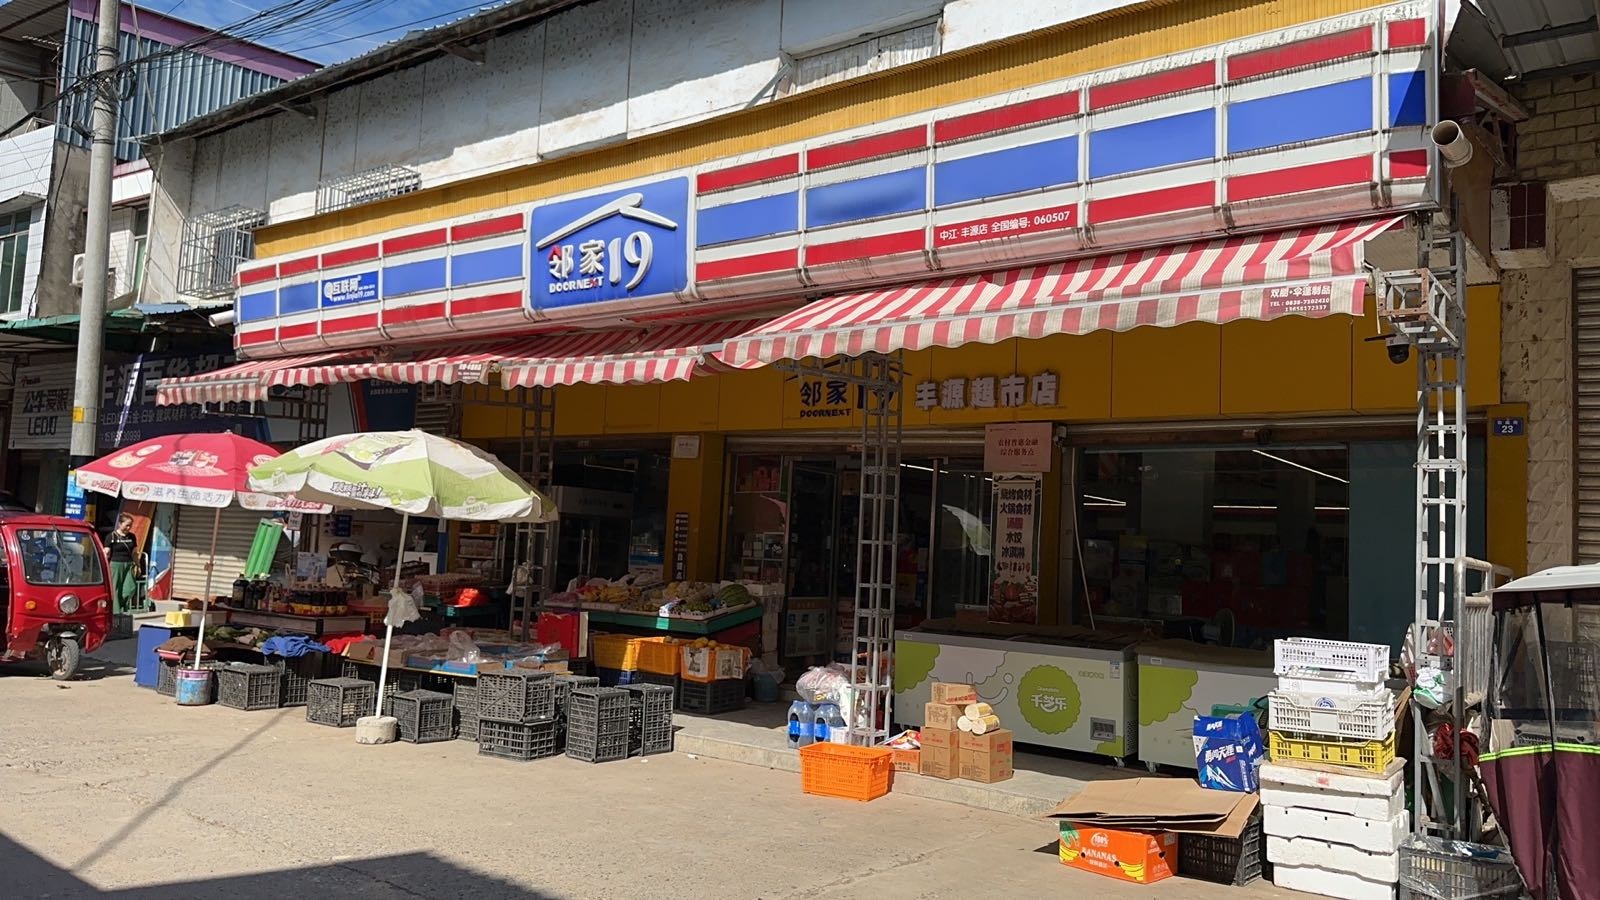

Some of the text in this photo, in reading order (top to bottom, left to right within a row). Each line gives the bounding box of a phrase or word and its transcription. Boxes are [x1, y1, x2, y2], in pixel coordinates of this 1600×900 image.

[1034, 210, 1071, 225] 060507
[549, 276, 604, 293] DOORNEXT
[916, 371, 1060, 411] 丰源超市店
[800, 408, 852, 417] DOORNEXT
[1501, 425, 1514, 433] 23
[152, 486, 226, 503] 滋养生命活力
[1000, 502, 1032, 515] 火锅食材
[1006, 531, 1023, 543] 水饺
